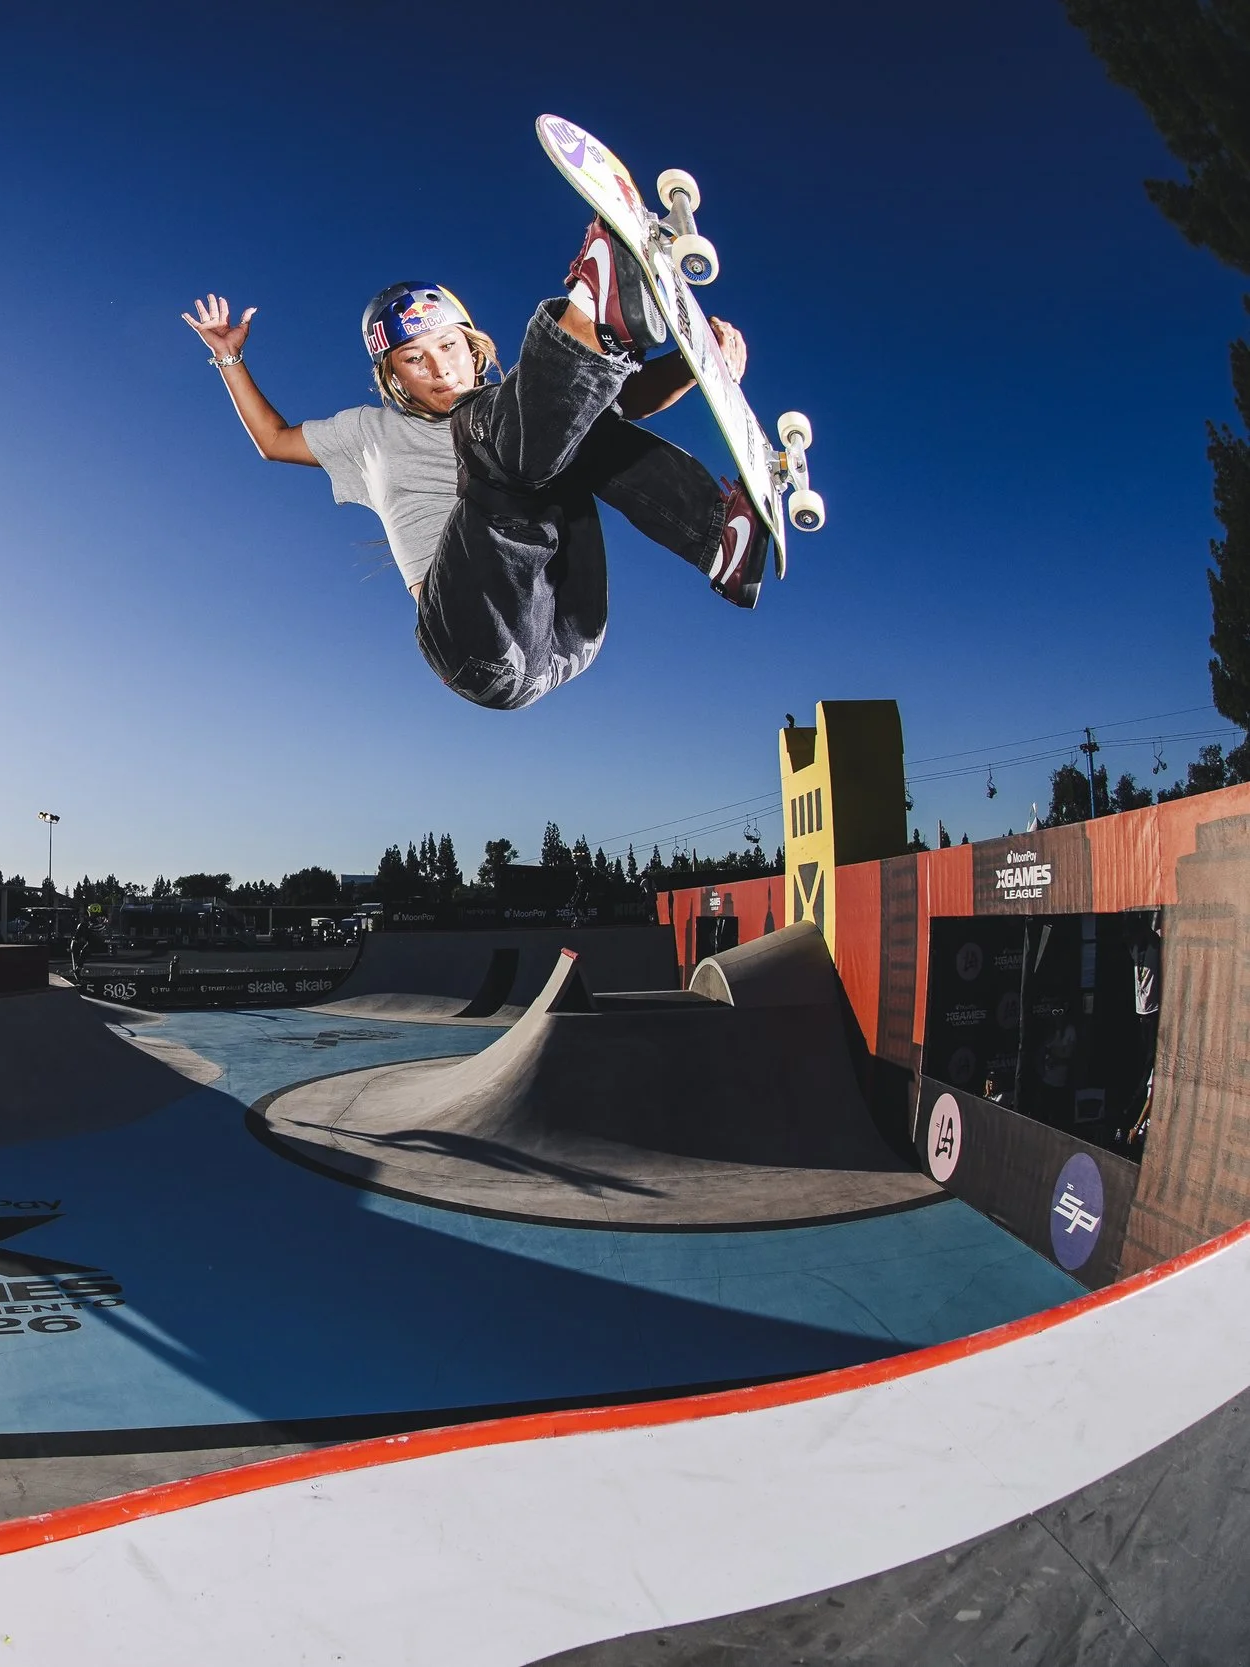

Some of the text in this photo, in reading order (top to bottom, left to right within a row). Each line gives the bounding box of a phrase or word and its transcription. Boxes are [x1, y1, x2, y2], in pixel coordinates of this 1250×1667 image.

[404, 311, 448, 334] Red Bull
[601, 334, 621, 352] IKE
[1012, 850, 1037, 864] MoonPay
[995, 863, 1052, 889] XGAMES
[1004, 888, 1043, 900] LEAGUE
[401, 912, 435, 923] MoonPay
[513, 907, 547, 920] MoonPay
[103, 982, 137, 998] 805
[247, 980, 289, 993] skate.
[1053, 1191, 1101, 1235] SP
